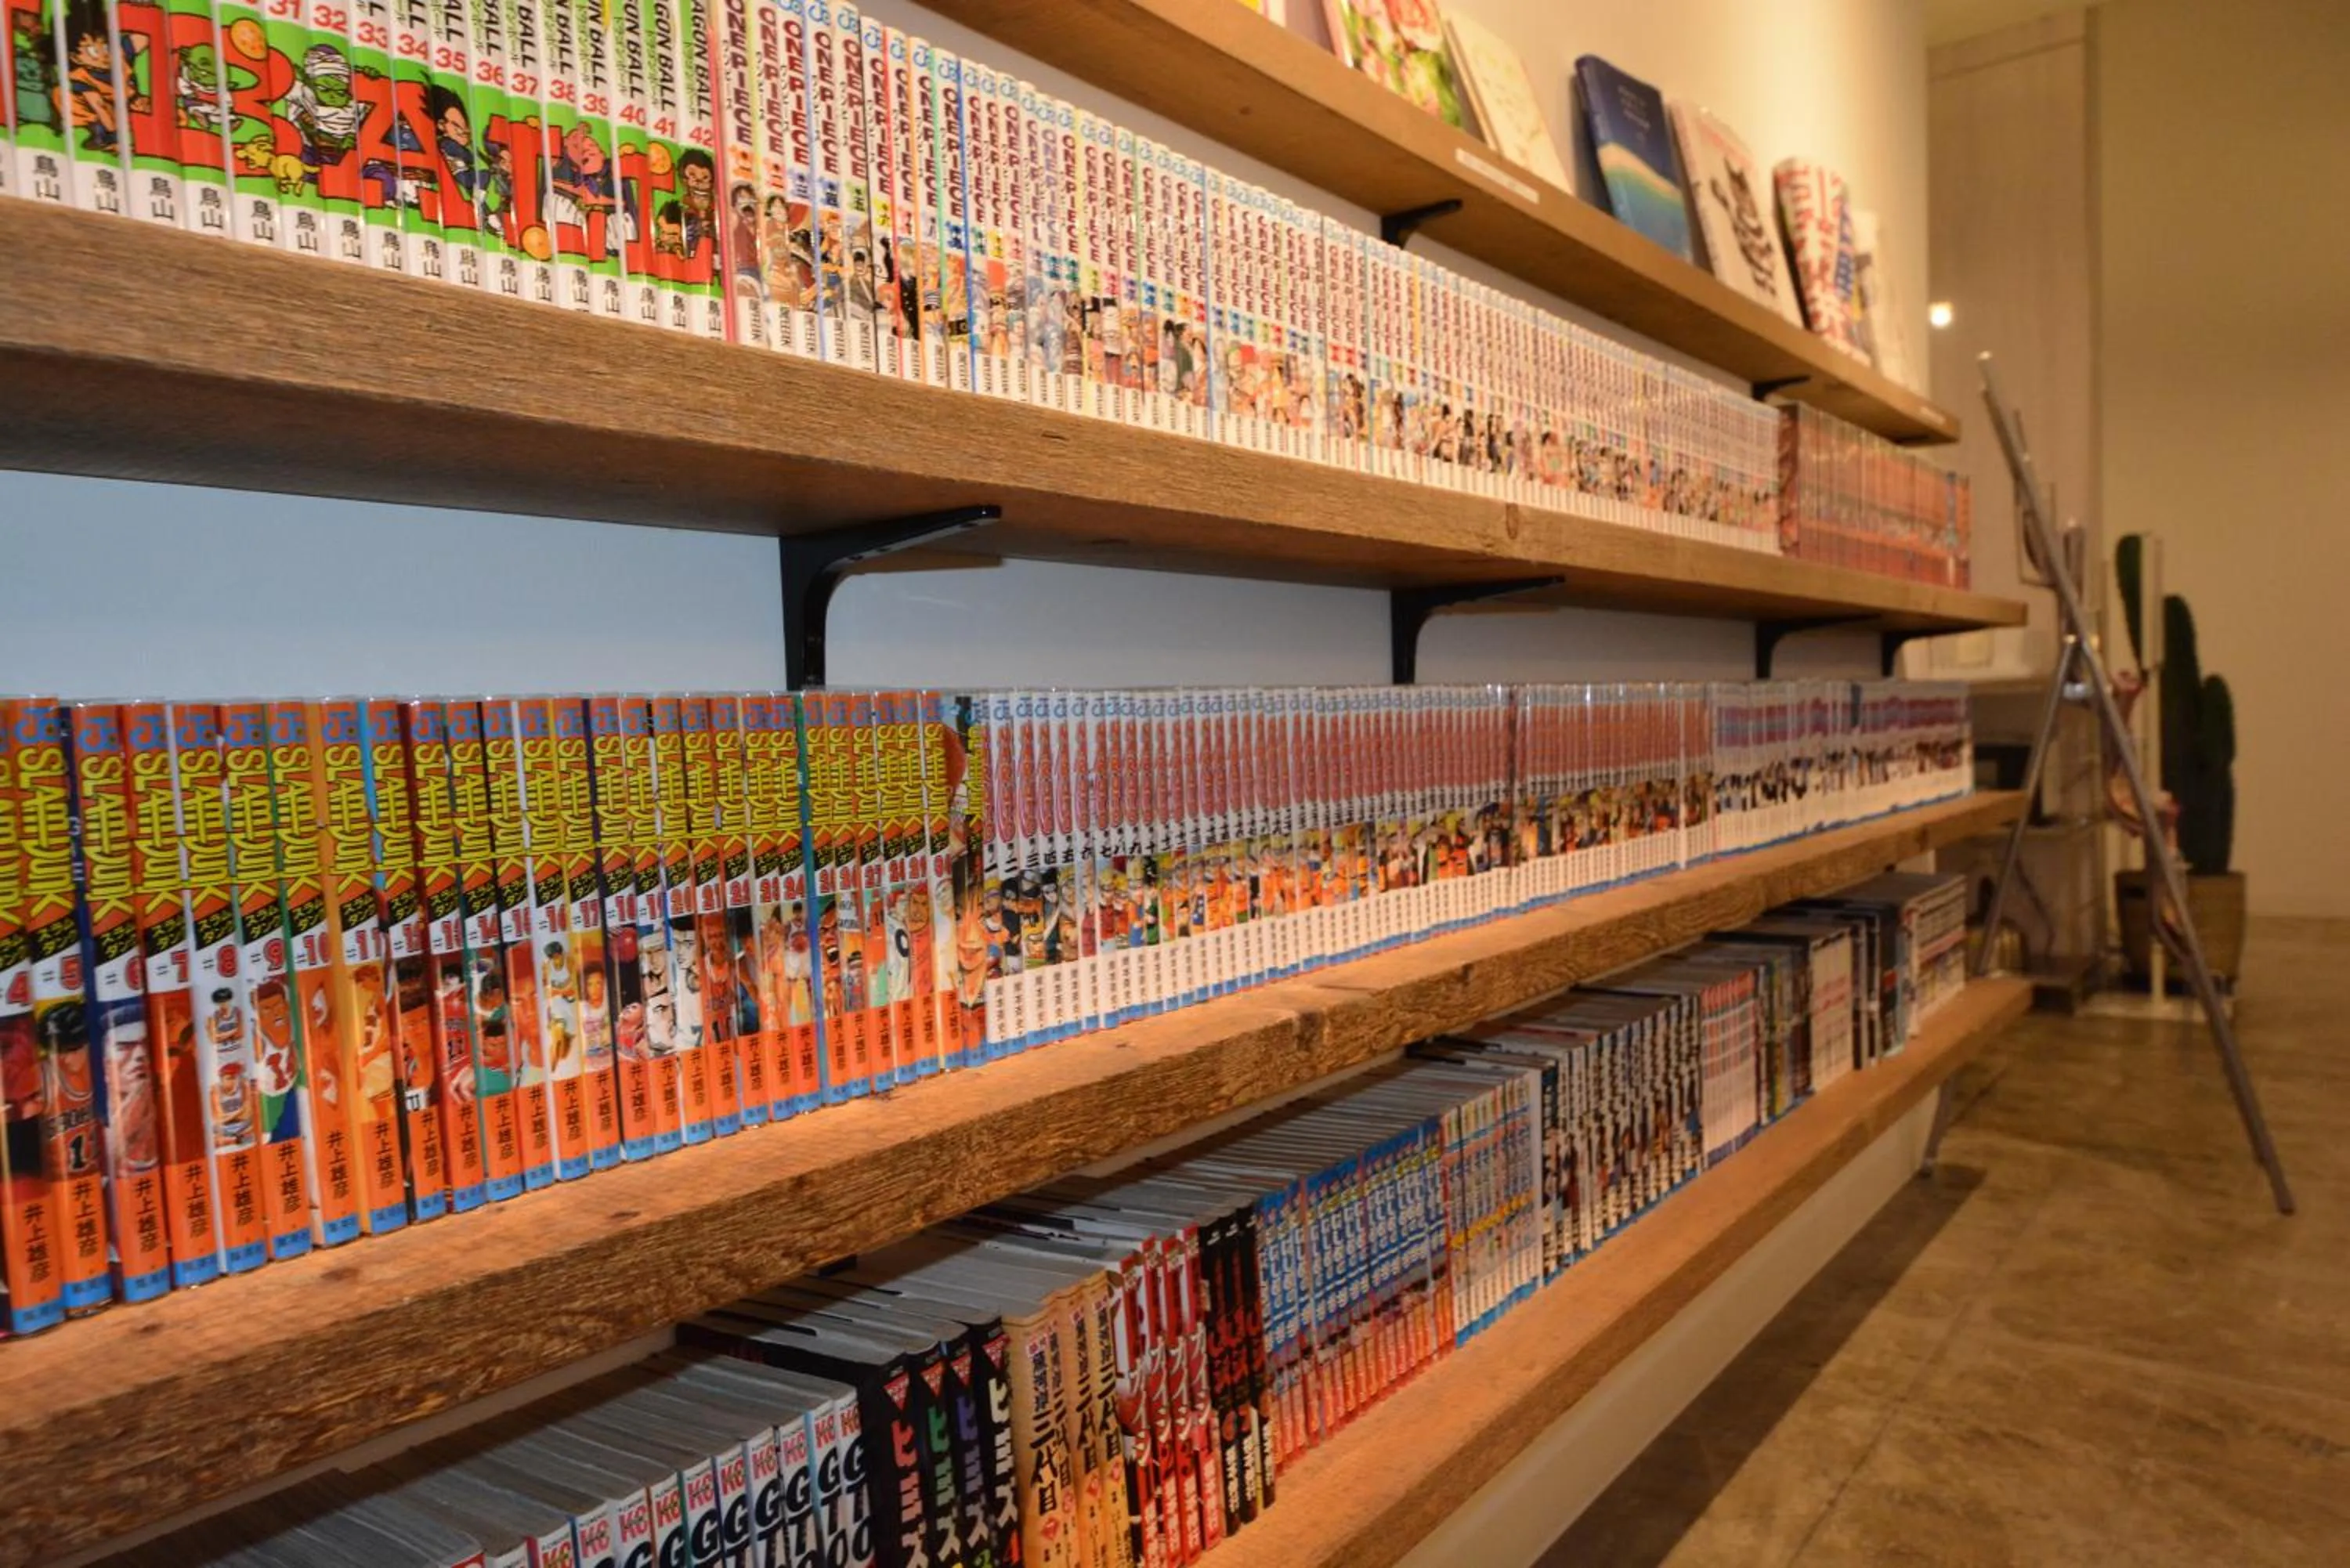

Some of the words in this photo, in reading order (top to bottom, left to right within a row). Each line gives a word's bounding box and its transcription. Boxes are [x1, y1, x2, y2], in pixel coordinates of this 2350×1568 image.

[314, 5, 348, 34] 32
[444, 0, 465, 42] ALL
[358, 21, 389, 49] 33
[397, 34, 429, 60] 34
[435, 46, 467, 73] 35
[476, 61, 504, 86] 36
[512, 73, 538, 96] 37
[550, 79, 576, 103] 38
[583, 94, 609, 116] 39
[620, 104, 646, 126] 40
[654, 117, 676, 139] 41
[689, 126, 714, 147] 42
